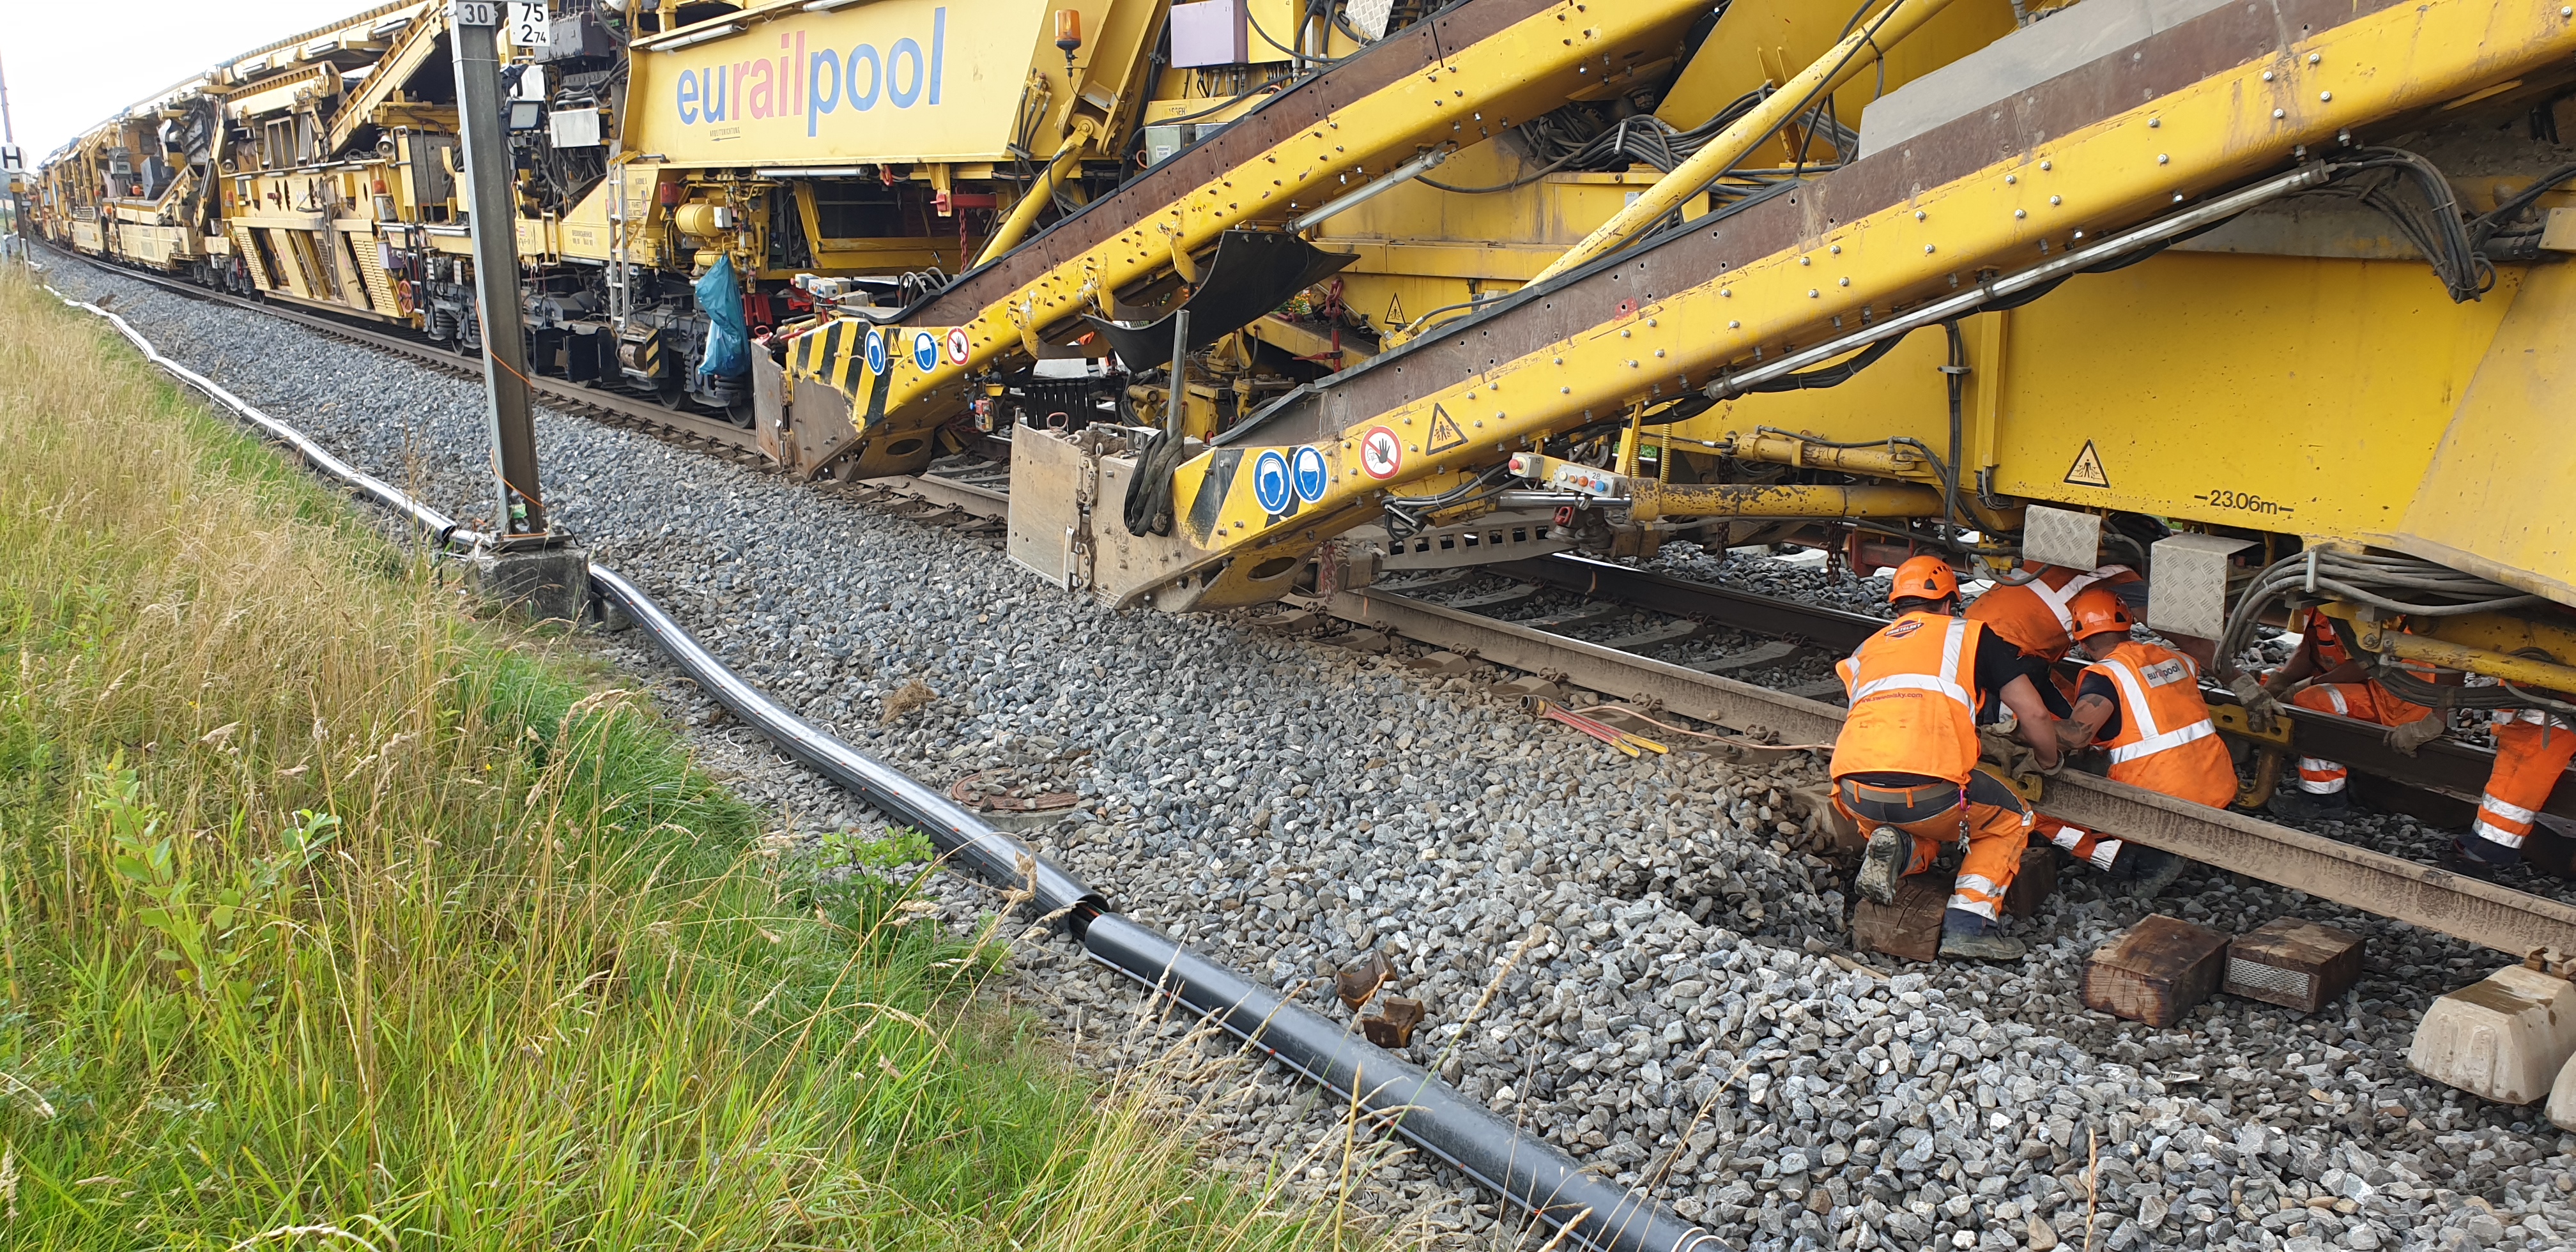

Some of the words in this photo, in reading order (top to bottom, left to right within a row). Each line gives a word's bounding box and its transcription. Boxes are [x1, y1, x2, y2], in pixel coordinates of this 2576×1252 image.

[464, 4, 487, 24] 30
[521, 3, 544, 22] 75
[677, 6, 946, 137] eurailpool
[1, 146, 23, 169] H
[1592, 472, 1601, 480] 28
[2210, 489, 2278, 515] 23.06m
